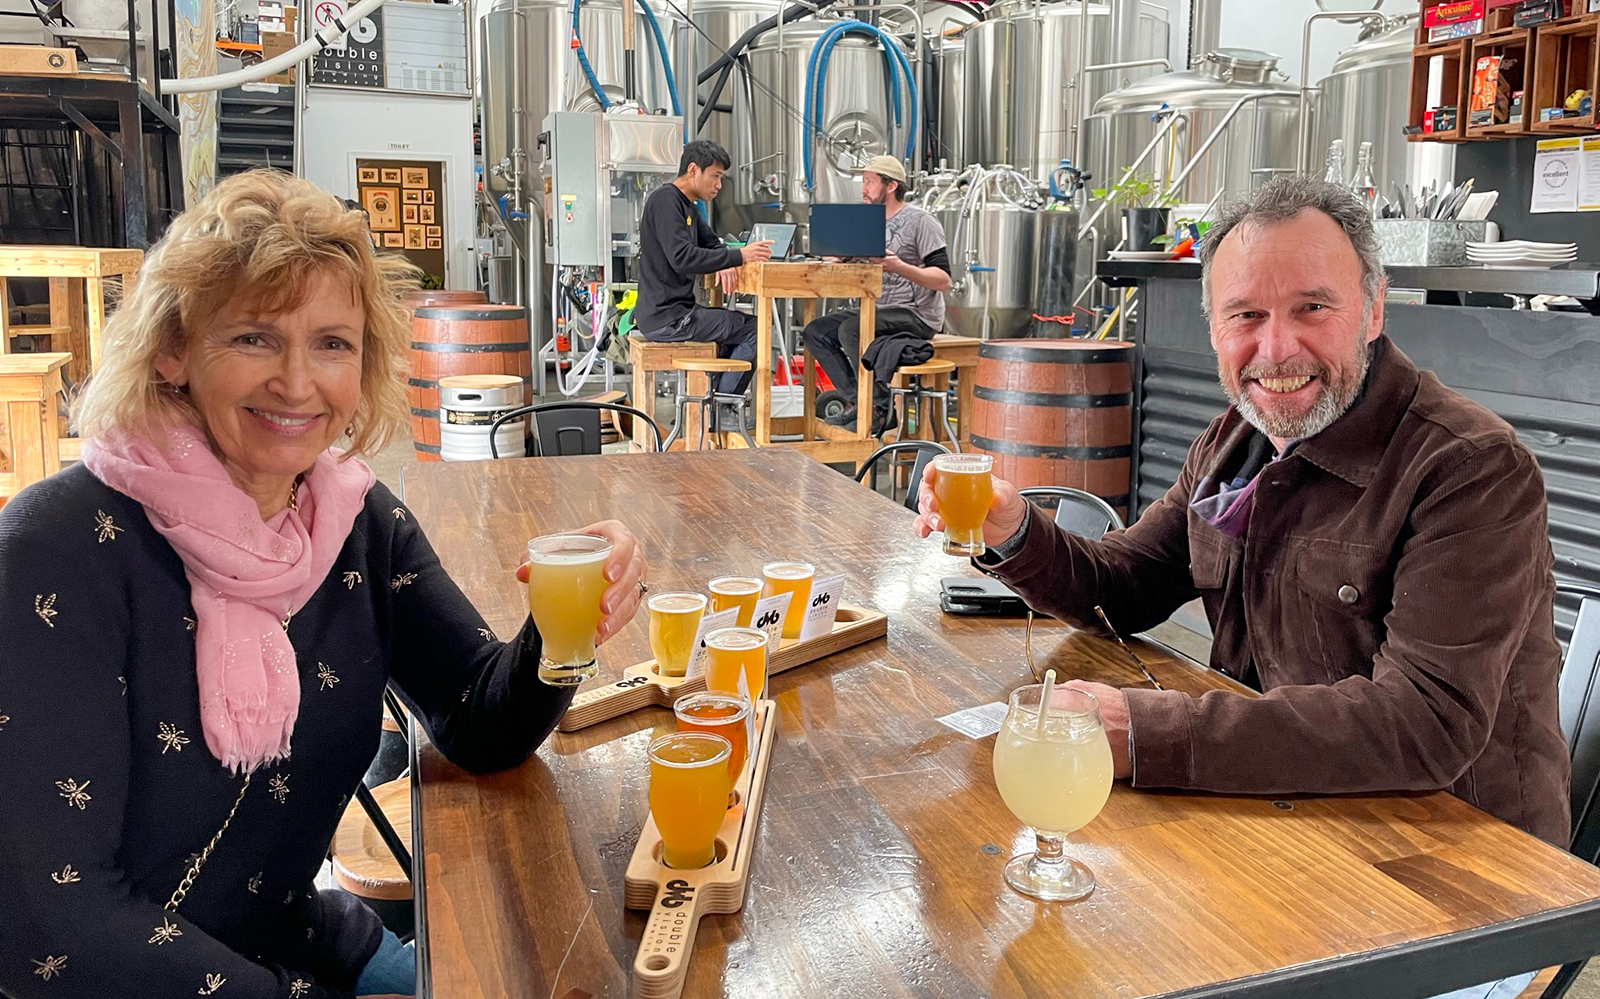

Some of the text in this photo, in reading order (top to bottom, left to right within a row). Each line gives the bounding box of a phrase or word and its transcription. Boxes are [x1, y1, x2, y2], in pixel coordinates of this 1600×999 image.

[314, 46, 377, 60] ouble
[653, 912, 672, 953] vision
[666, 912, 688, 953] double
